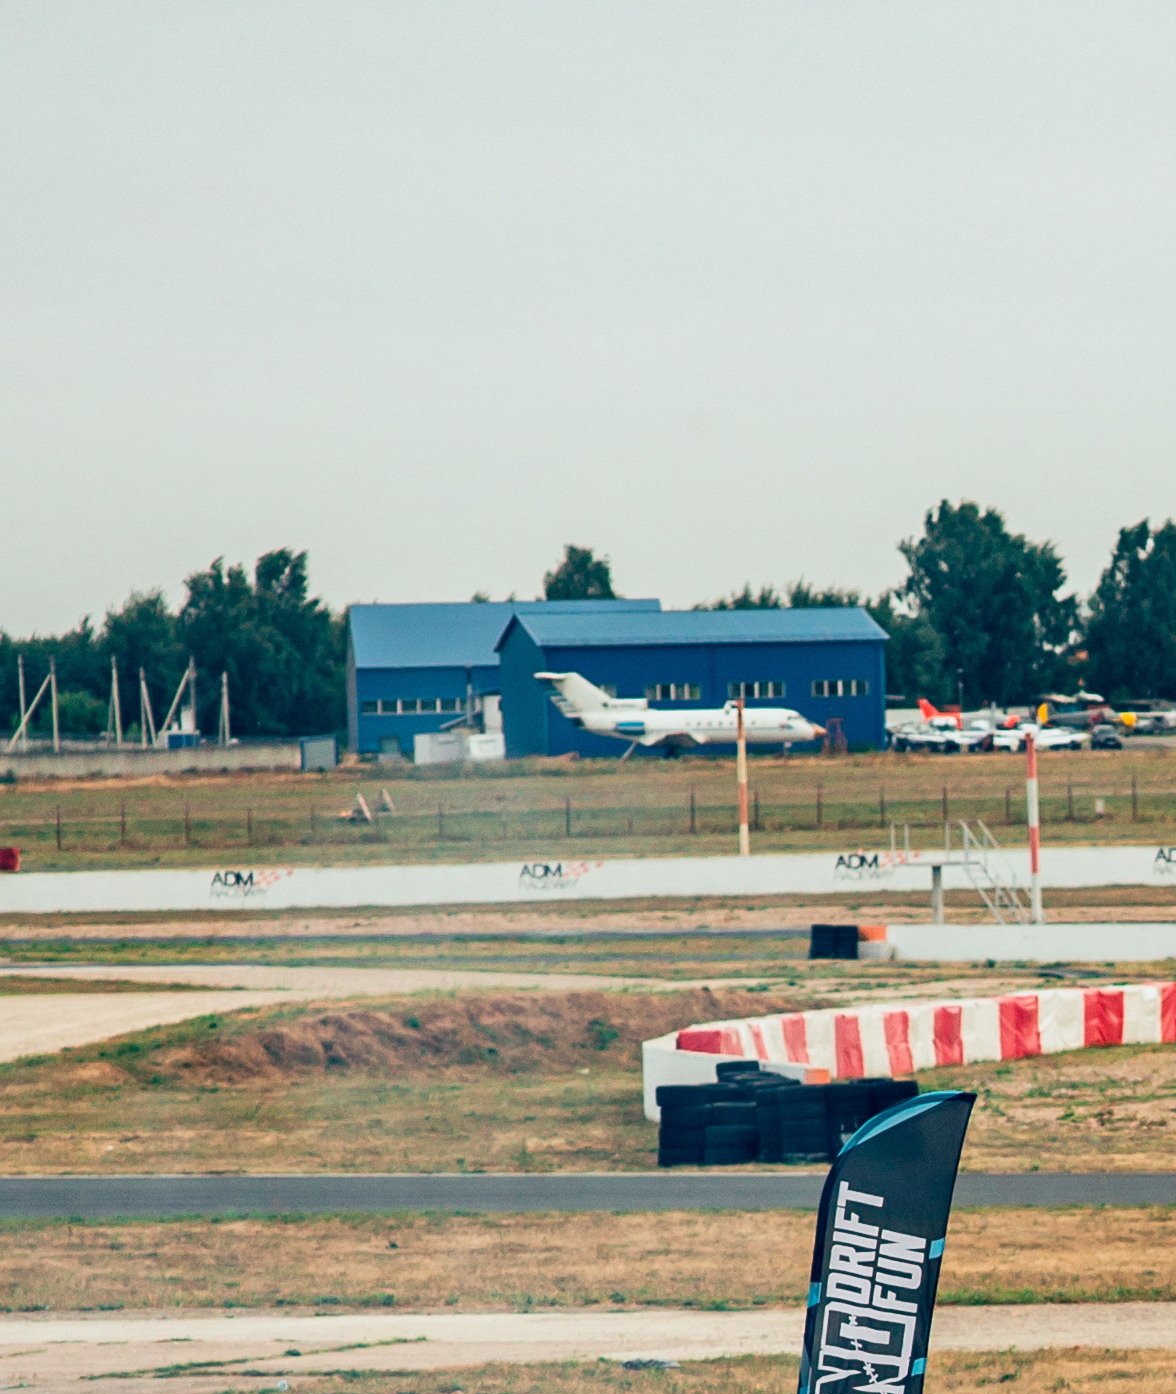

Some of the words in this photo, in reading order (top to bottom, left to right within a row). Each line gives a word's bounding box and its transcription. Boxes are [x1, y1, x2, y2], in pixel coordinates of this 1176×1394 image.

[835, 854, 878, 869] ADM
[211, 871, 254, 887] ADM
[520, 863, 563, 879] ADM
[826, 1180, 884, 1305] DRIFT
[872, 1229, 927, 1314] FUN
